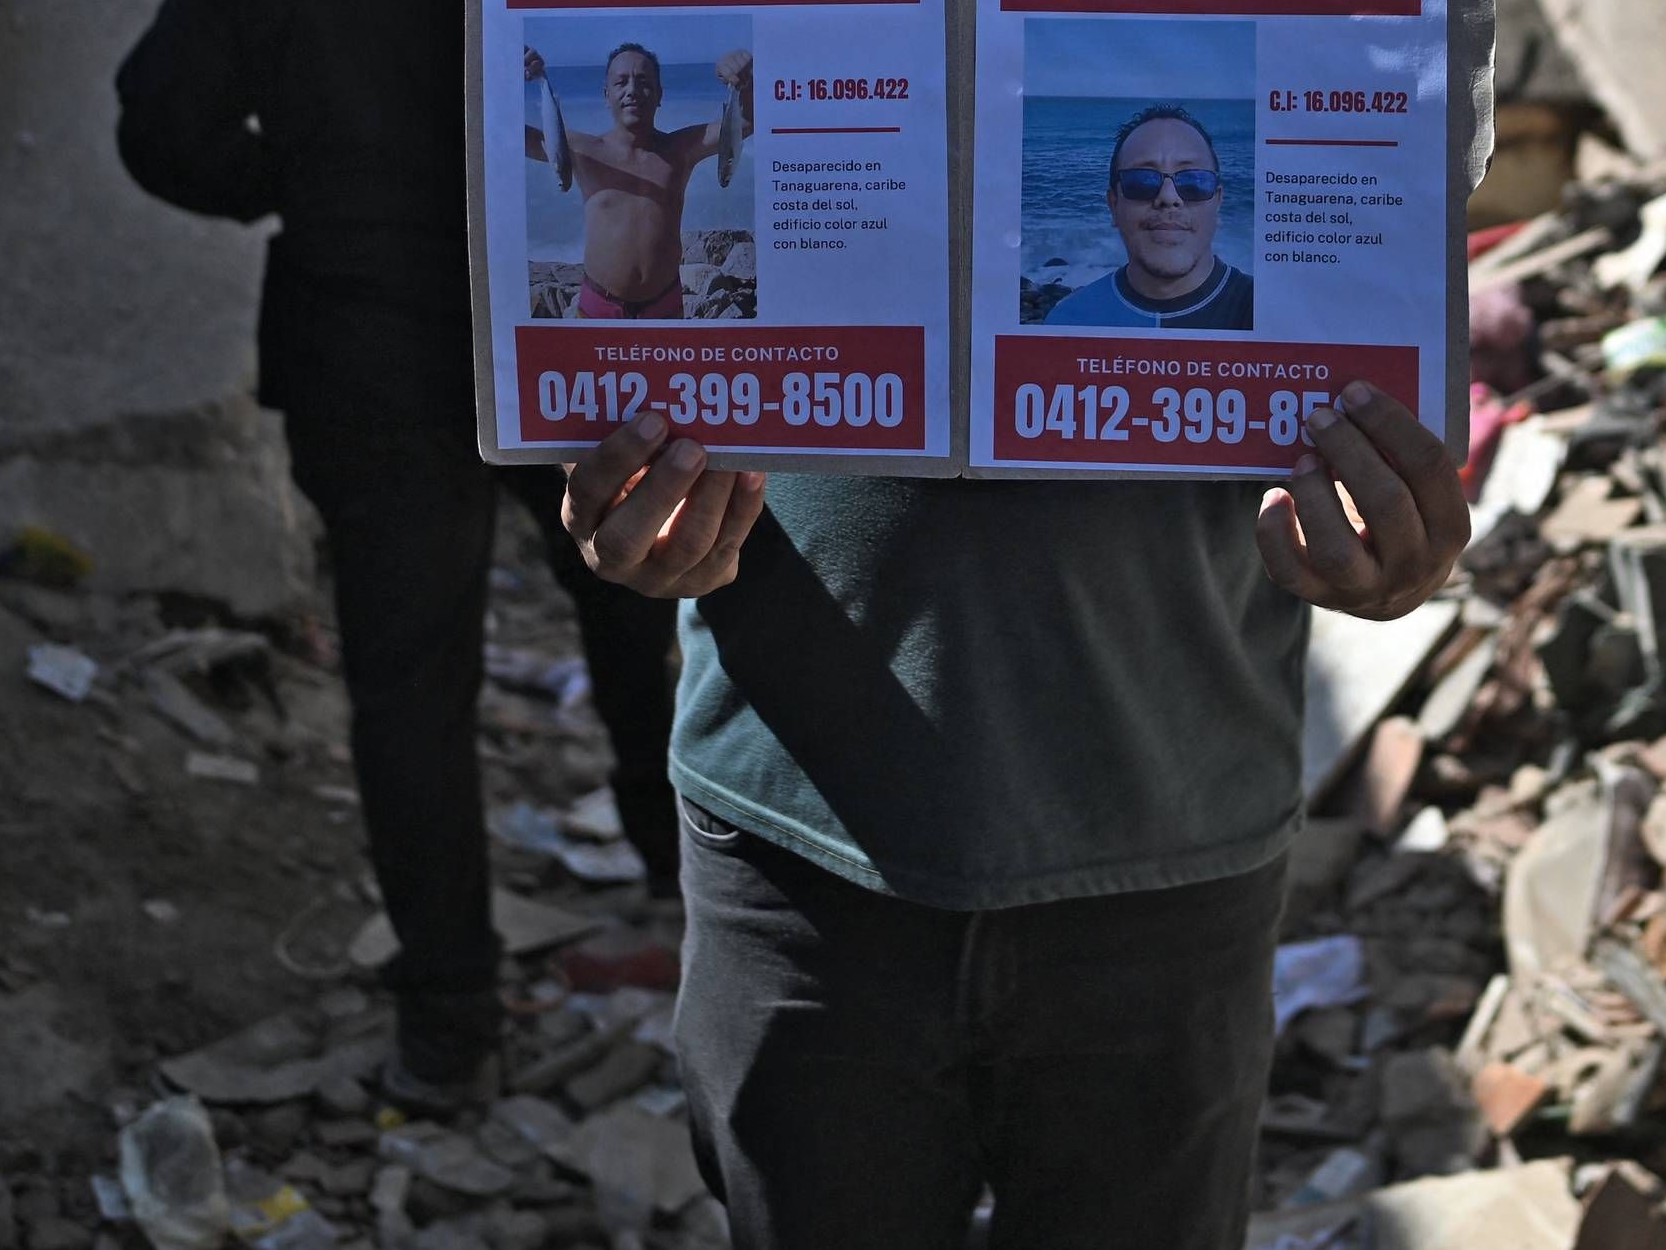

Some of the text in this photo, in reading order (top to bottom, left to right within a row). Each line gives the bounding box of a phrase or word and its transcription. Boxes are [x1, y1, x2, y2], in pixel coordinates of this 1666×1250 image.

[775, 78, 909, 101] C.I: 16.096.422
[1269, 90, 1407, 114] C.I: 16.096.422
[773, 160, 881, 174] Desaparecido en
[773, 179, 905, 193] Tanaguarena, caribe
[1266, 172, 1377, 186] Desaparecido en
[773, 200, 808, 211] costa
[812, 199, 831, 210] del
[1265, 191, 1403, 206] Tanaguarena, caribe
[773, 218, 887, 230] edificio color azul
[1265, 212, 1352, 225] costa del sol,
[774, 238, 846, 249] con blanco.
[1265, 231, 1382, 245] edificio color azul
[1265, 251, 1340, 263] con blanco.
[595, 344, 839, 362] TELÉFONO DE CONTACTO
[1077, 356, 1329, 380] TELÉFONO DE CONTACTO
[538, 371, 904, 428] 0412-399-8500
